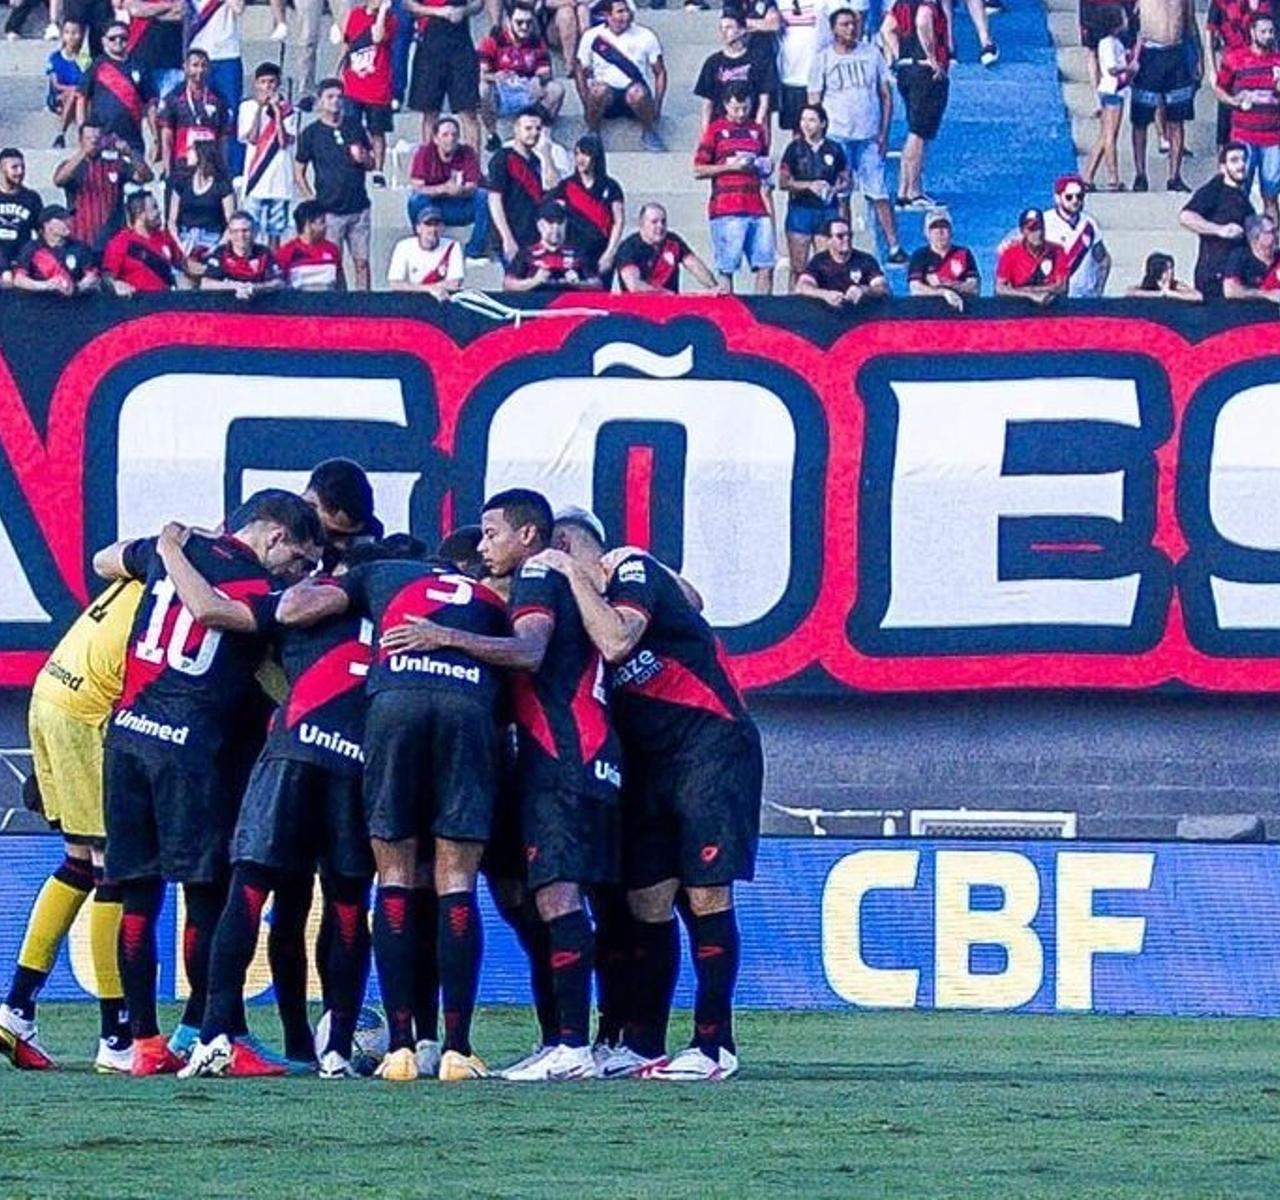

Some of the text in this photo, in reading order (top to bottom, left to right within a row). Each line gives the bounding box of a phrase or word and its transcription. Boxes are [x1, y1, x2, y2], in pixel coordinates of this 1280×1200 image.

[135, 575, 223, 676] 10
[390, 654, 481, 685] Unimed
[114, 708, 191, 746] Unimed
[821, 848, 1157, 1011] CBF
